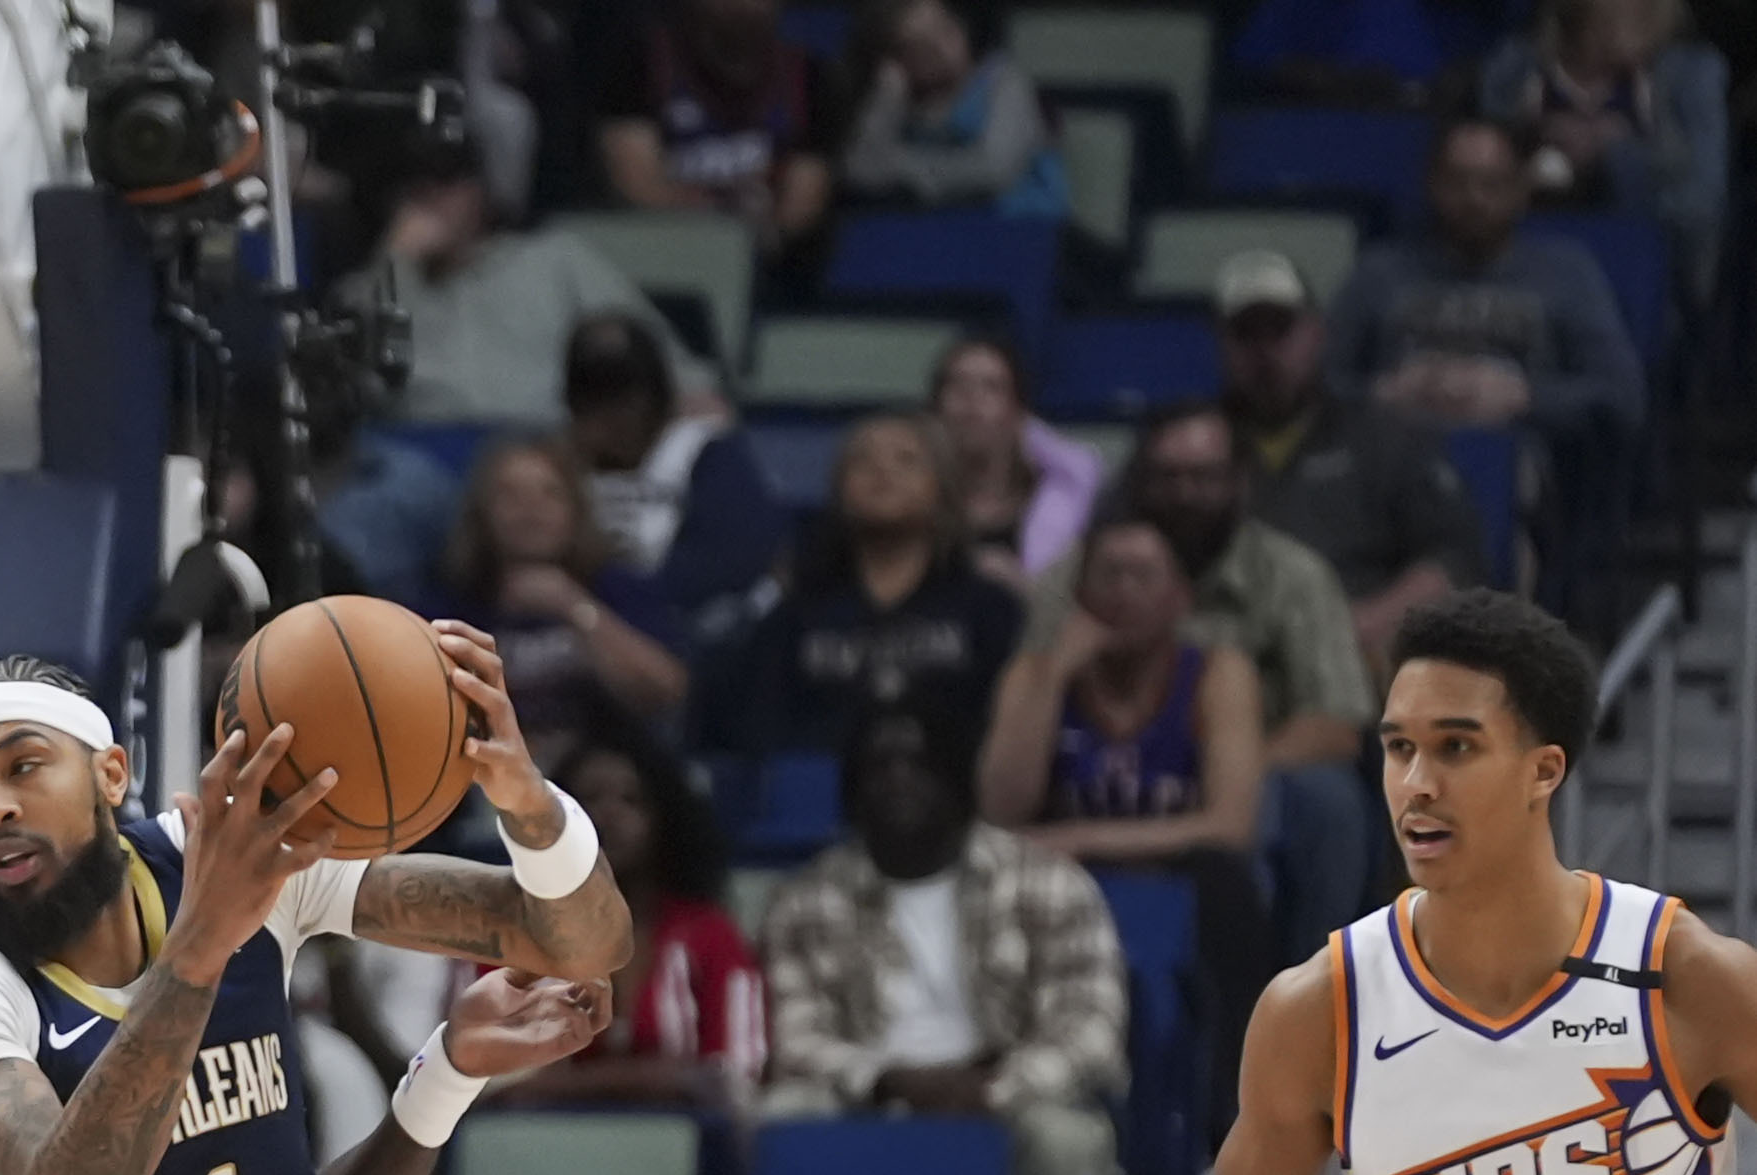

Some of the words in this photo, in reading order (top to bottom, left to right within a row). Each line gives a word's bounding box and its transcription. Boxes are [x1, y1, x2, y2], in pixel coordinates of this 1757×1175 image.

[1604, 966, 1620, 983] AL
[1552, 1016, 1628, 1043] PayPal
[171, 1032, 288, 1144] LEANS
